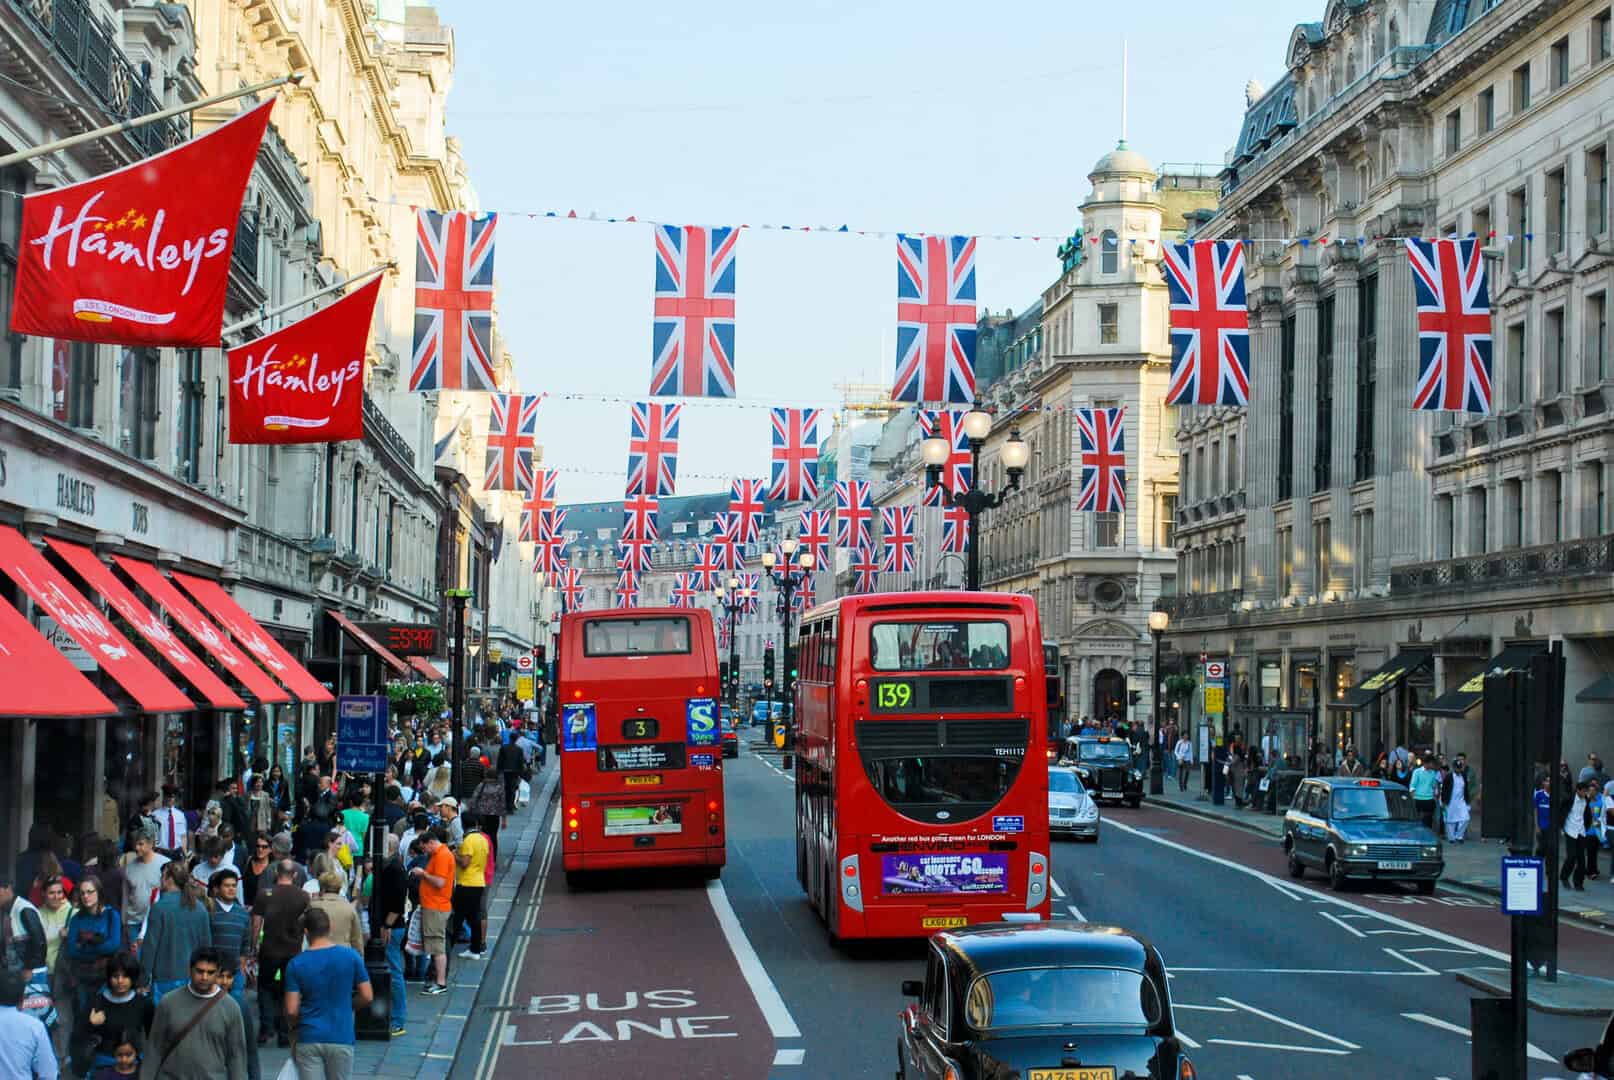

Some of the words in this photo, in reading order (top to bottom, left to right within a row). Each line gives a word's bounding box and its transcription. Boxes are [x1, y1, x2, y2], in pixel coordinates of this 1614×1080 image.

[30, 190, 229, 296] Hamleys
[233, 343, 360, 407] Hamleys
[878, 683, 912, 708] 139
[635, 721, 646, 736] 3
[995, 748, 1025, 756] TEH1112
[932, 835, 948, 843] going
[949, 835, 966, 843] green
[925, 864, 957, 876] QUOTE
[961, 857, 983, 875] 60
[528, 989, 697, 1015] BUS
[502, 1015, 739, 1046] LANE
